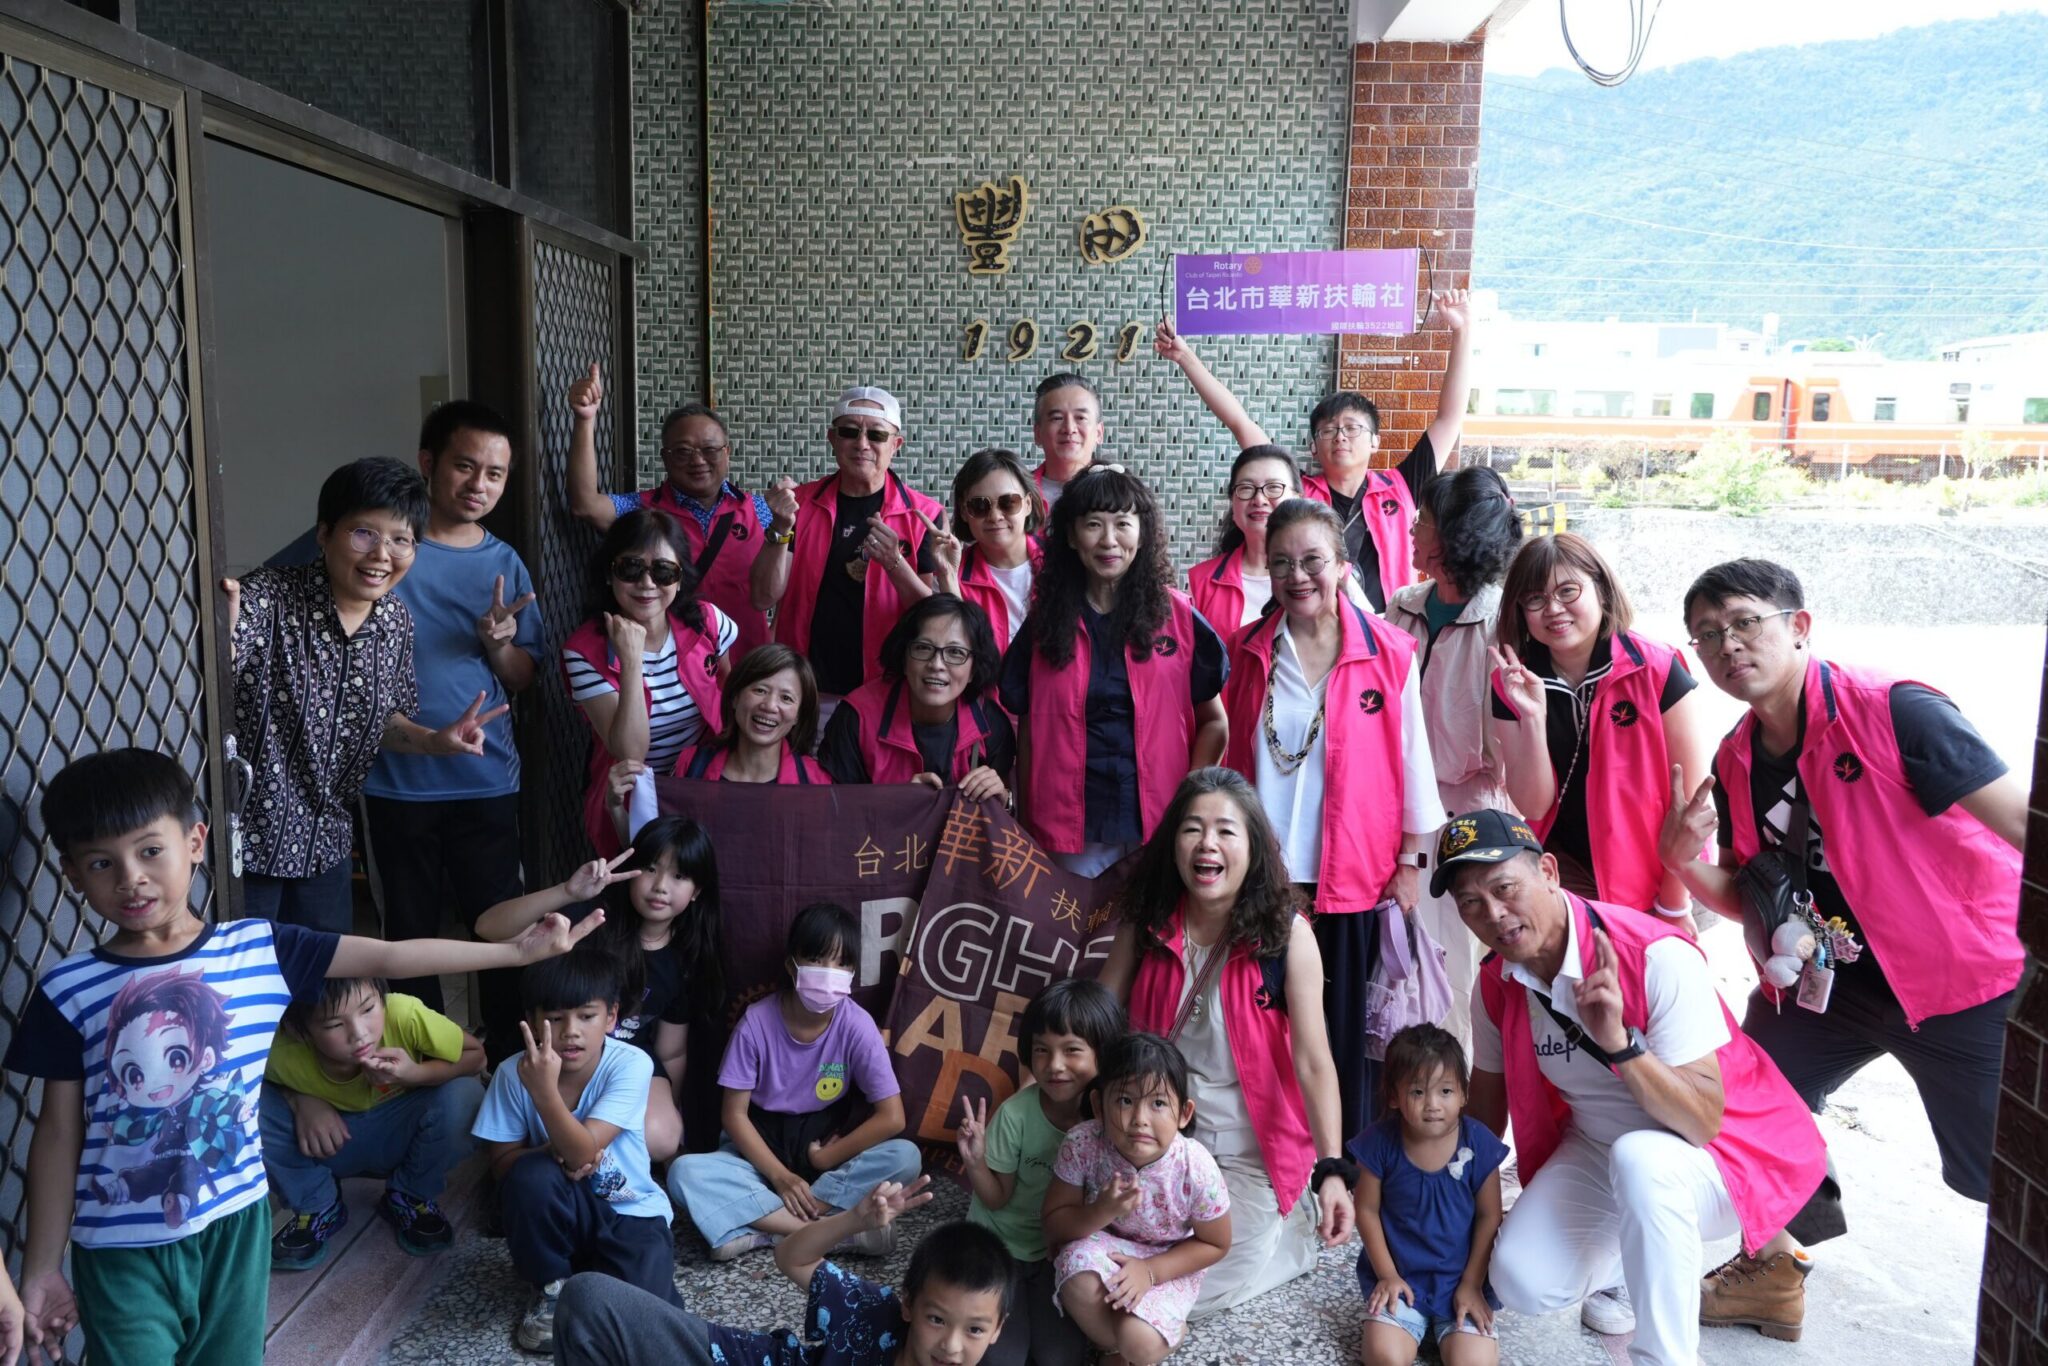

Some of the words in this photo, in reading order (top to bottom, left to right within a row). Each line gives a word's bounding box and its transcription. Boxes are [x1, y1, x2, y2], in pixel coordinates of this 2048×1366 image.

[1213, 261, 1242, 271] Rotary
[1186, 283, 1405, 311] 台北市華新扶輪社
[964, 318, 1143, 362] 1921
